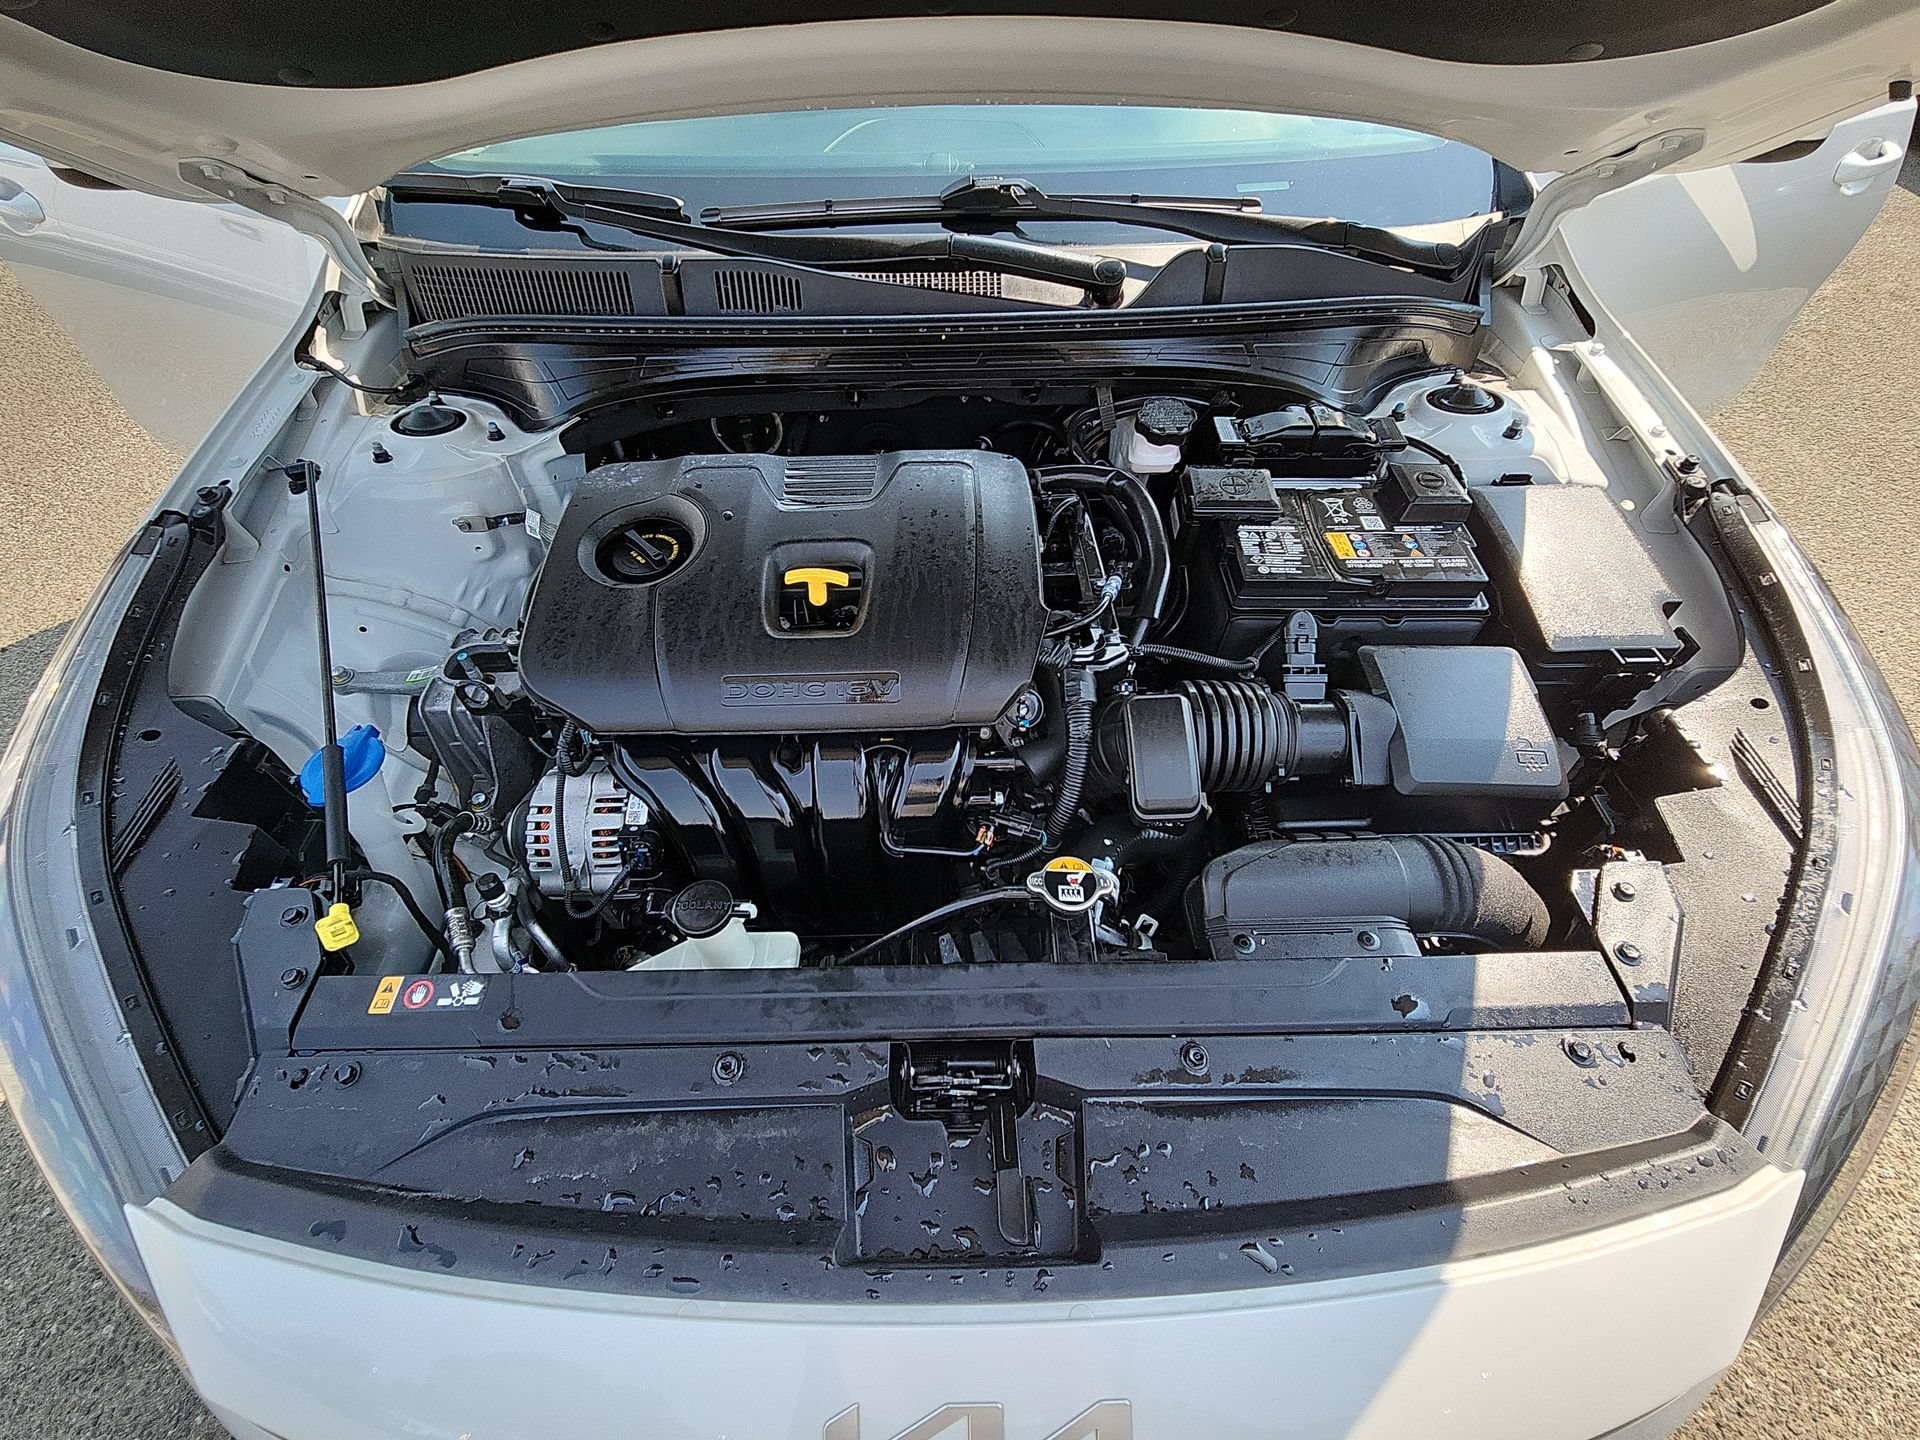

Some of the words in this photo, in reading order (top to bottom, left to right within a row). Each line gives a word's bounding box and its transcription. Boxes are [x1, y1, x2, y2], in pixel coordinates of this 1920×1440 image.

[724, 681, 826, 699] DOHC
[835, 679, 898, 698] 16V
[676, 901, 731, 911] COOLANT
